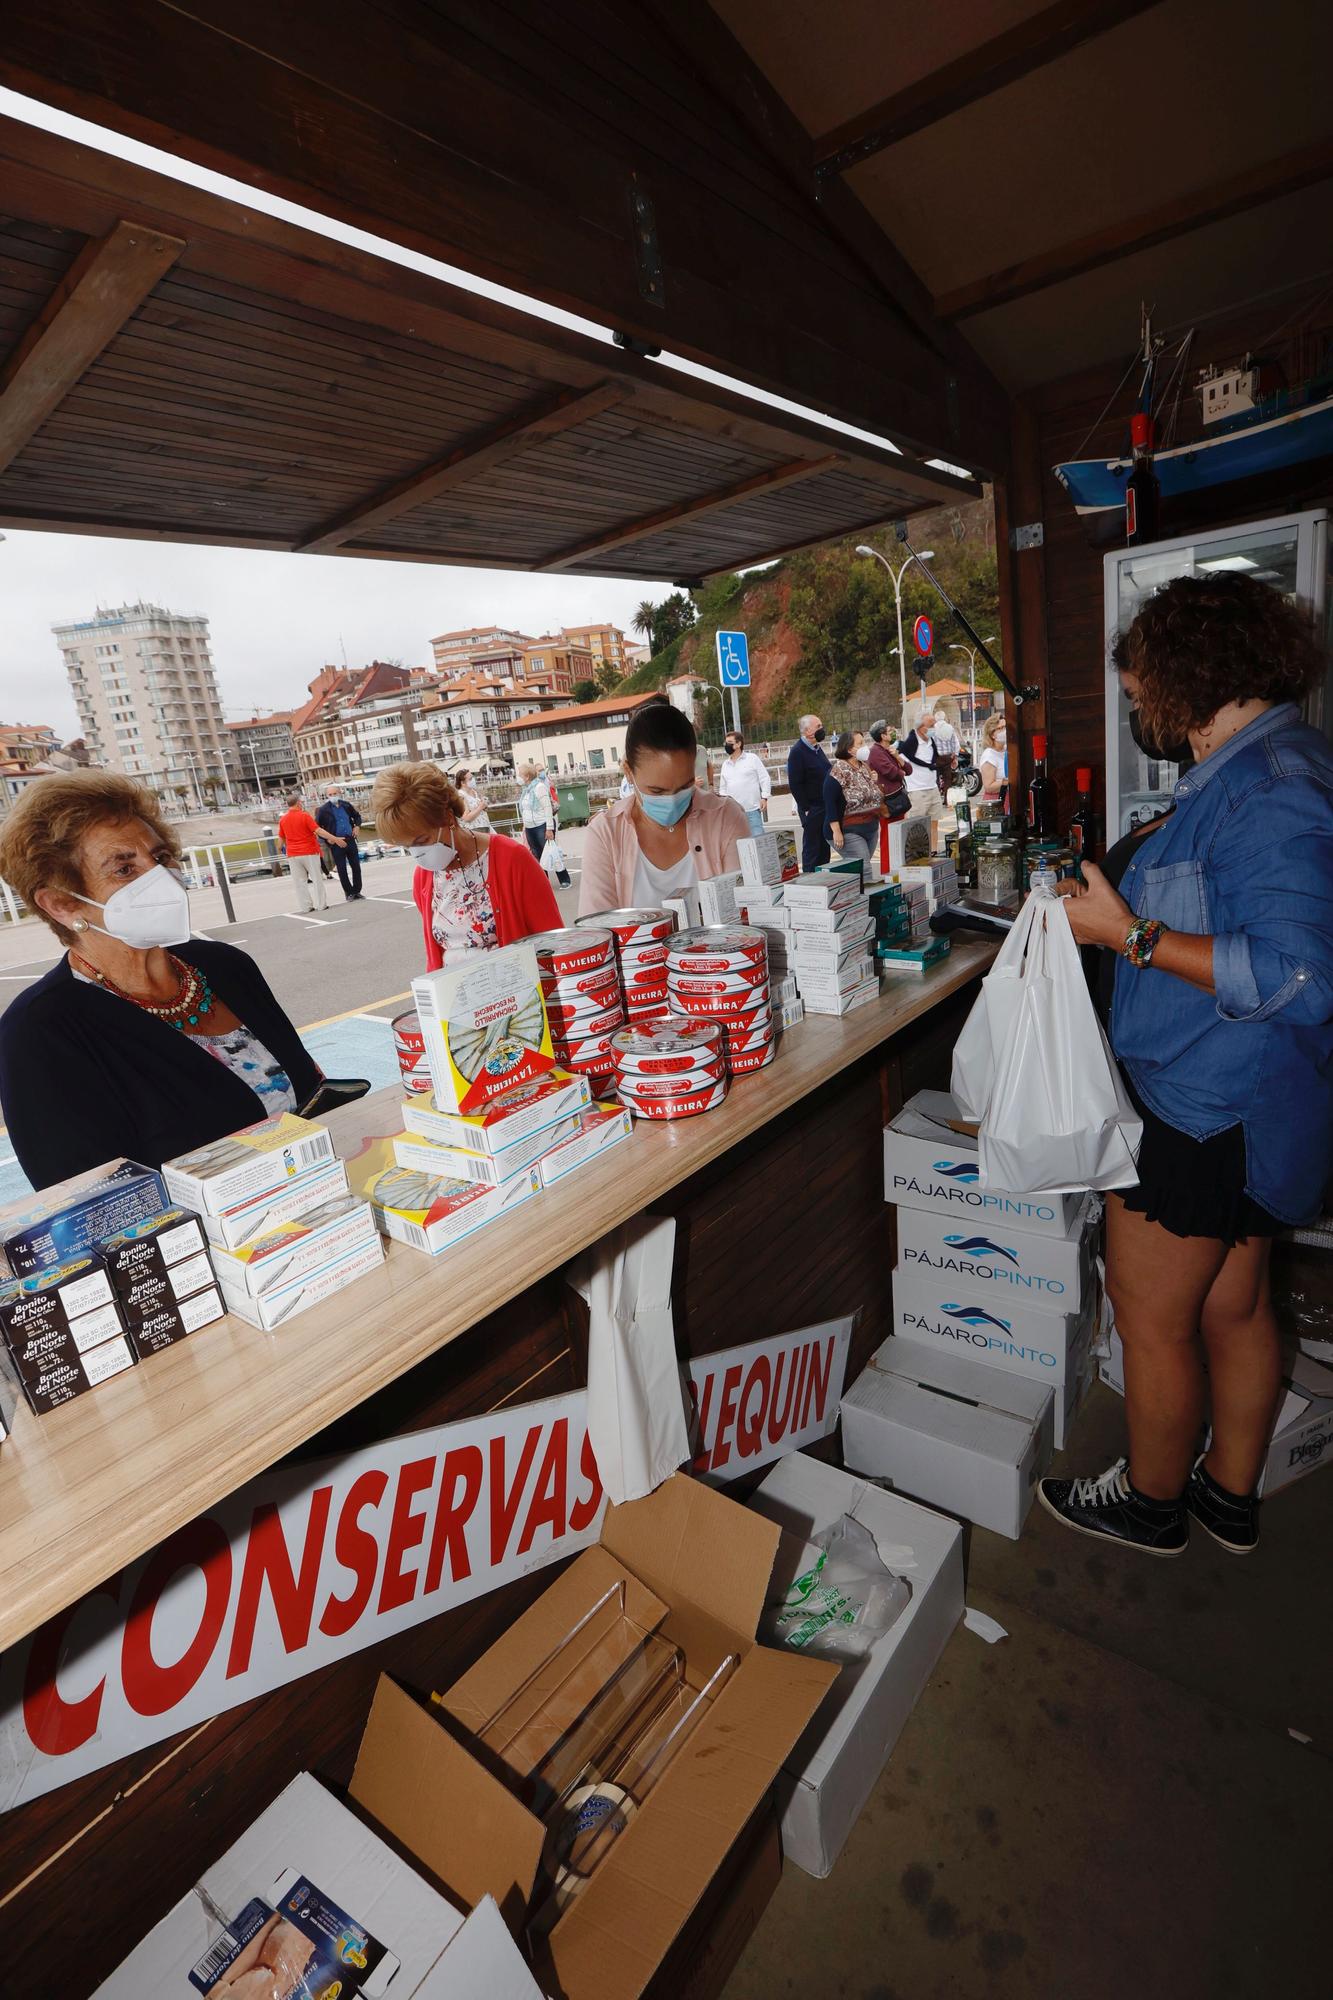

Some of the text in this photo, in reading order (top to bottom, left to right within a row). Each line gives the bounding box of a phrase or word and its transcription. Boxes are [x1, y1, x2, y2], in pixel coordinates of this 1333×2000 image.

[893, 1175, 1054, 1220] PÁJAROPINTO
[117, 1247, 155, 1268] del Norte
[120, 1243, 147, 1259] Bonito
[904, 1248, 1064, 1294] PÁJAROPINTO
[128, 1282, 166, 1303] del Norte
[132, 1278, 158, 1294] Bonito
[11, 1300, 56, 1324] del Norte
[16, 1296, 47, 1314] Bonito
[140, 1316, 177, 1338] del Norte
[143, 1313, 169, 1330] Bonito
[23, 1334, 67, 1360] del Norte
[27, 1331, 58, 1349] Bonito
[903, 1313, 1056, 1367] PÁJAROPINTO
[36, 1369, 79, 1394] del Norte
[40, 1365, 70, 1384] Bonito
[22, 1417, 603, 1756] CONSERVAS
[242, 1917, 265, 1943] Bonito
[231, 1944, 242, 1959] del
[209, 1959, 231, 1983] Norte
